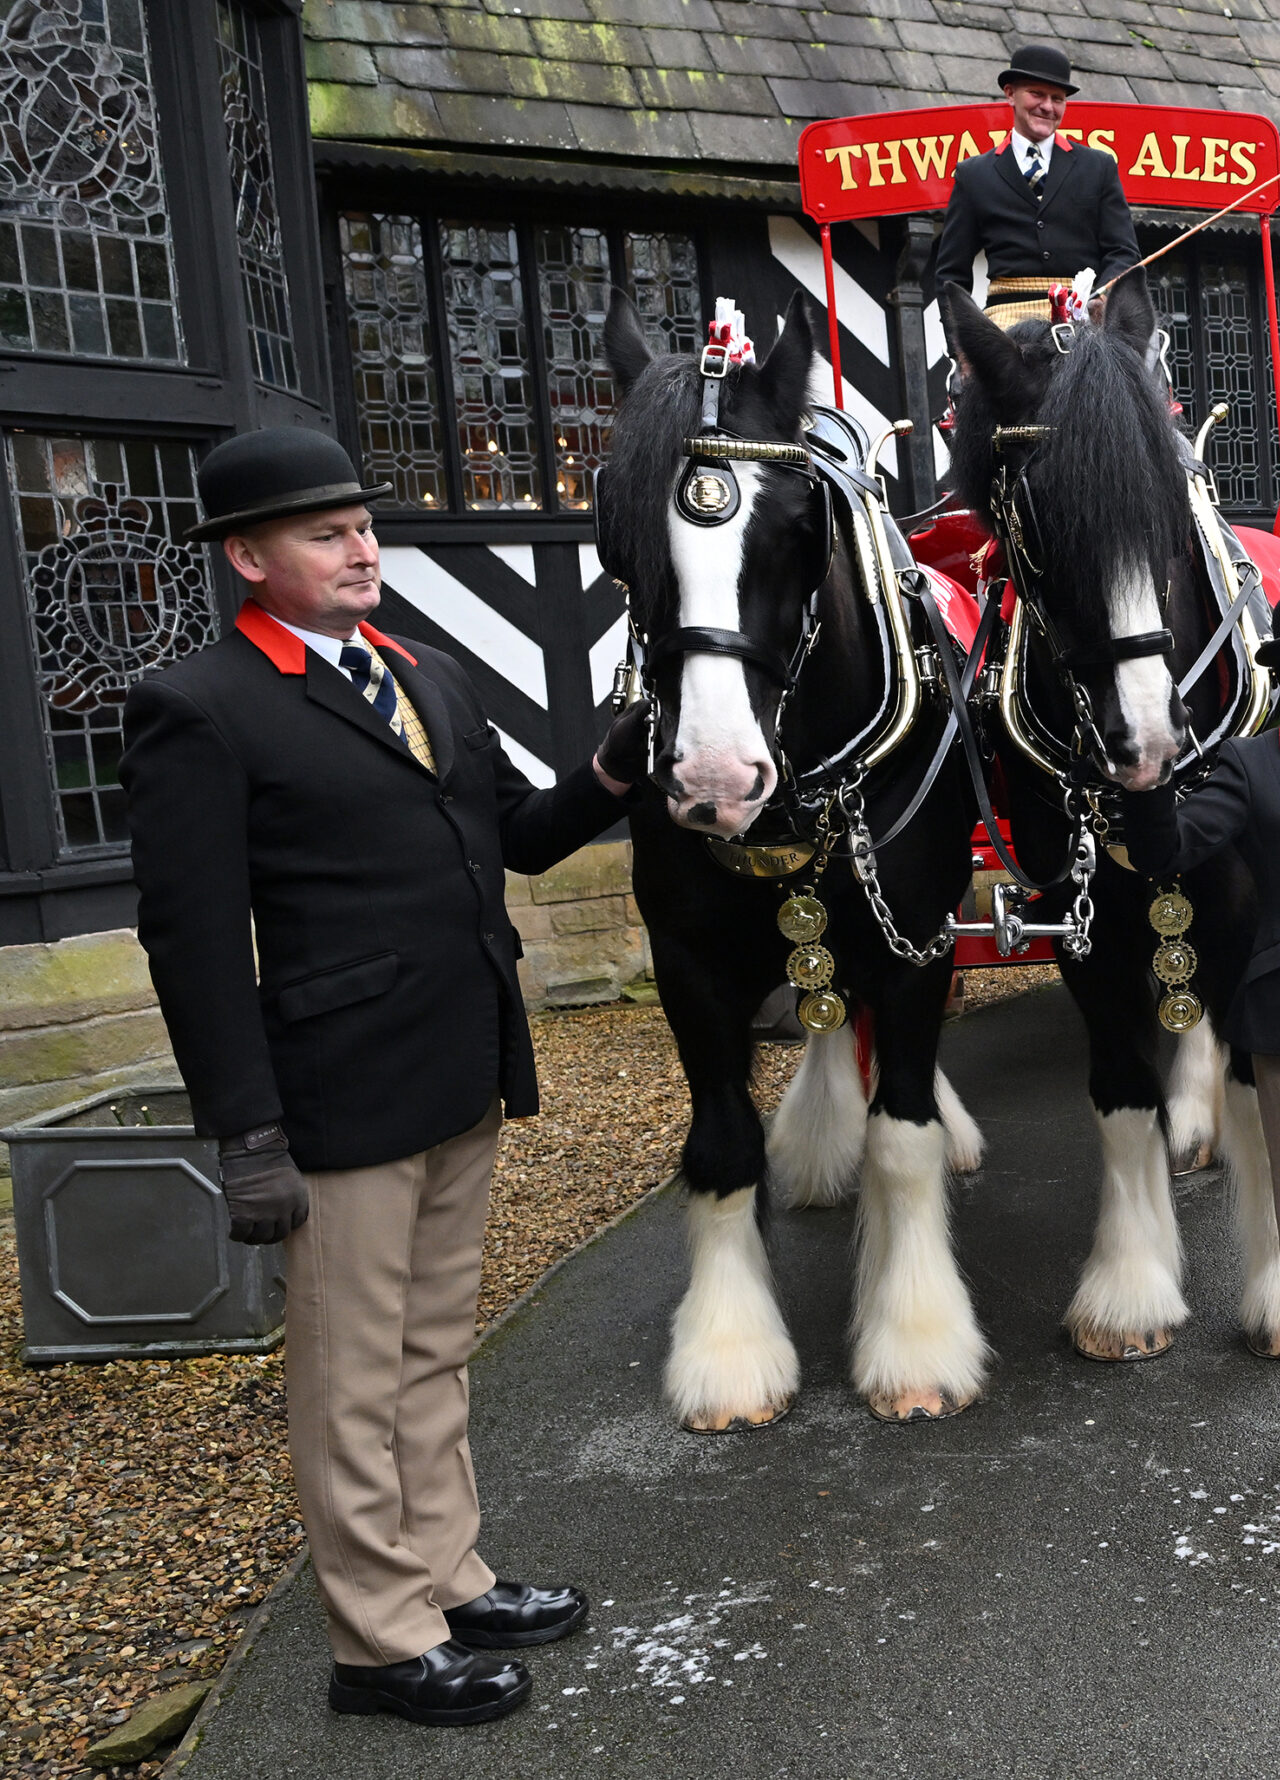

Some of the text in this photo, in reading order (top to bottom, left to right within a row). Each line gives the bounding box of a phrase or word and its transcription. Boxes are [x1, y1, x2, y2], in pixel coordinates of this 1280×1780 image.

[824, 129, 1257, 190] THWAS ALES
[729, 852, 800, 868] THUNDER
